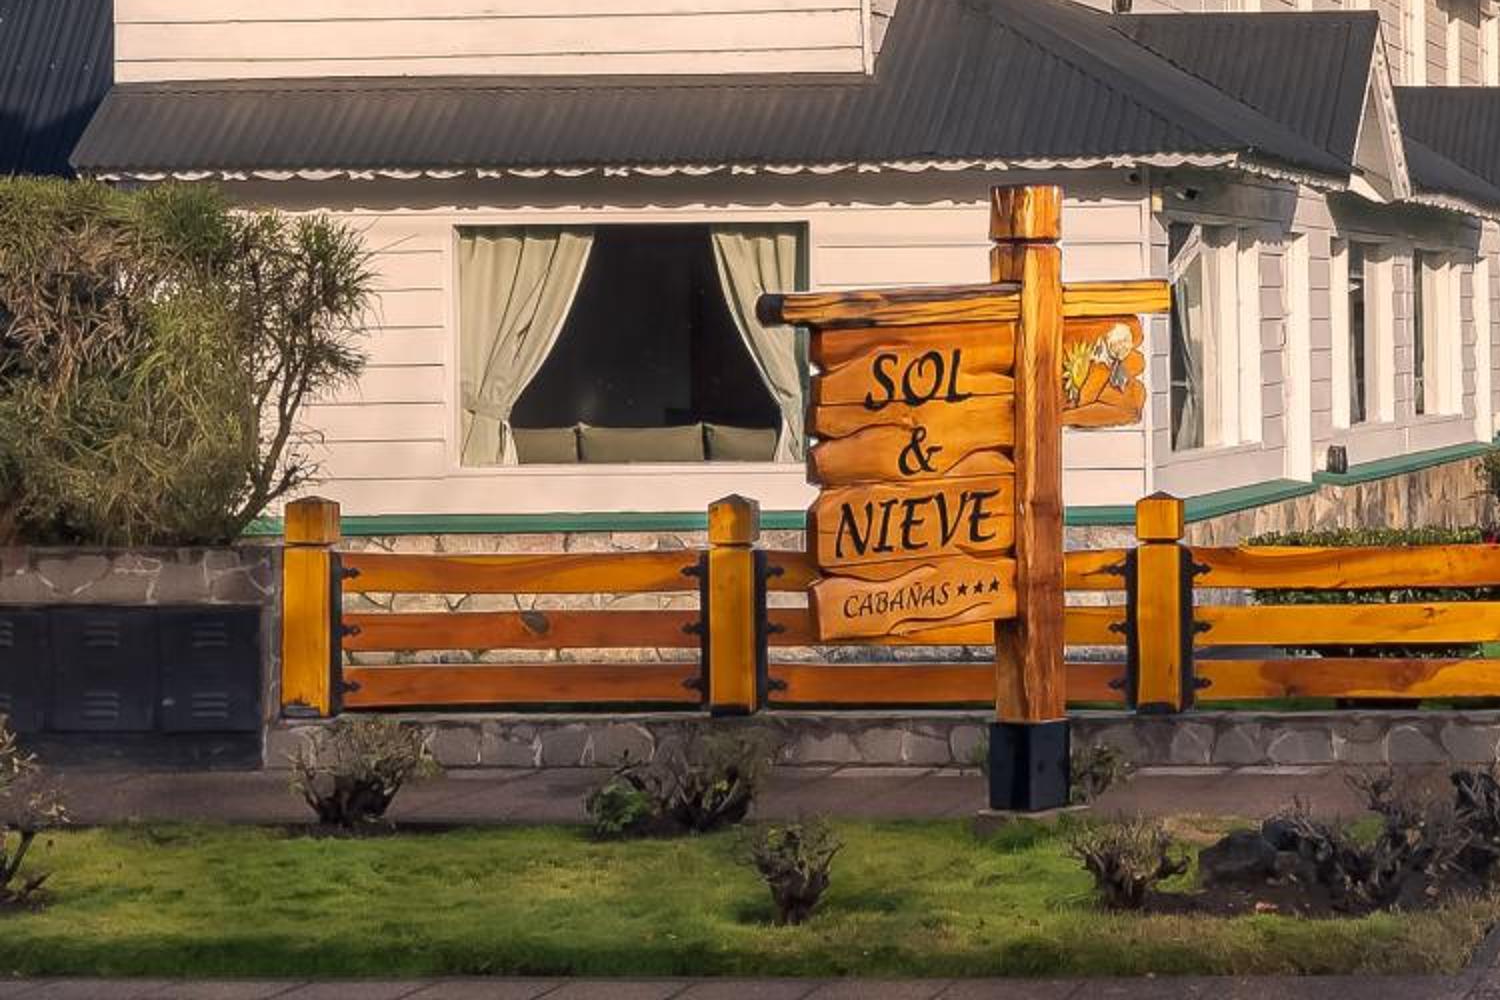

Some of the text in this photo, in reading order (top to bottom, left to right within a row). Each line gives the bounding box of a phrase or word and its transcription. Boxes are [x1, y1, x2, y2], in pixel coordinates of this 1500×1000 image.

[864, 349, 972, 410] SOL
[898, 426, 943, 476] &
[836, 488, 1001, 558] NIEVE
[843, 581, 951, 618] CABAÑAS
